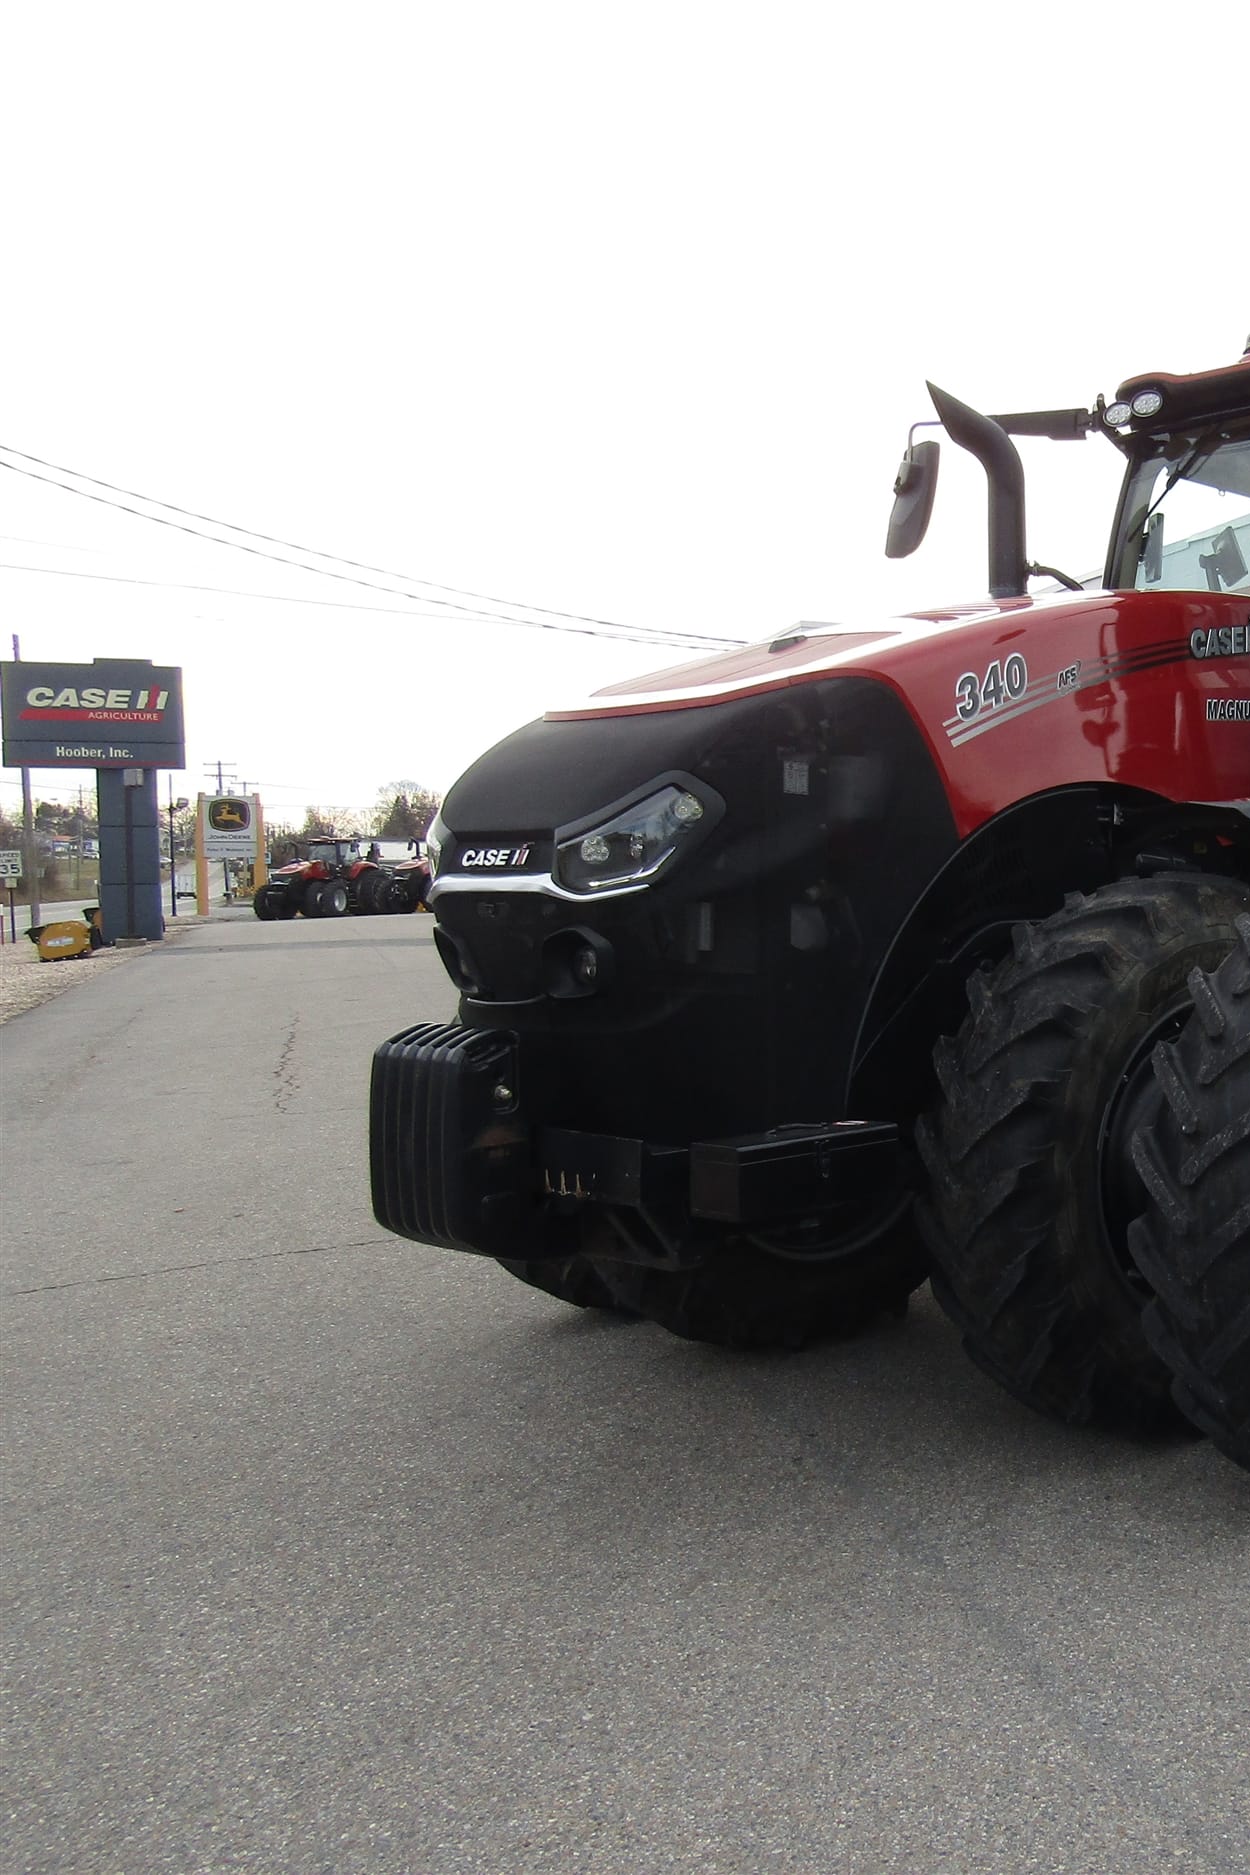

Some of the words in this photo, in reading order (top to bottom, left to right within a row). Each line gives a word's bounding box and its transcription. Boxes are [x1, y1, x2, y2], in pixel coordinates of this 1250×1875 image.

[1190, 626, 1244, 659] CASE
[956, 652, 1028, 722] 340
[1057, 664, 1078, 690] AFS
[26, 686, 132, 709] CASE
[88, 711, 160, 721] AGRICULTURE
[56, 746, 106, 759] Hoober,
[109, 747, 134, 759] Inc.
[461, 849, 511, 867] CASE
[0, 863, 20, 874] 35
